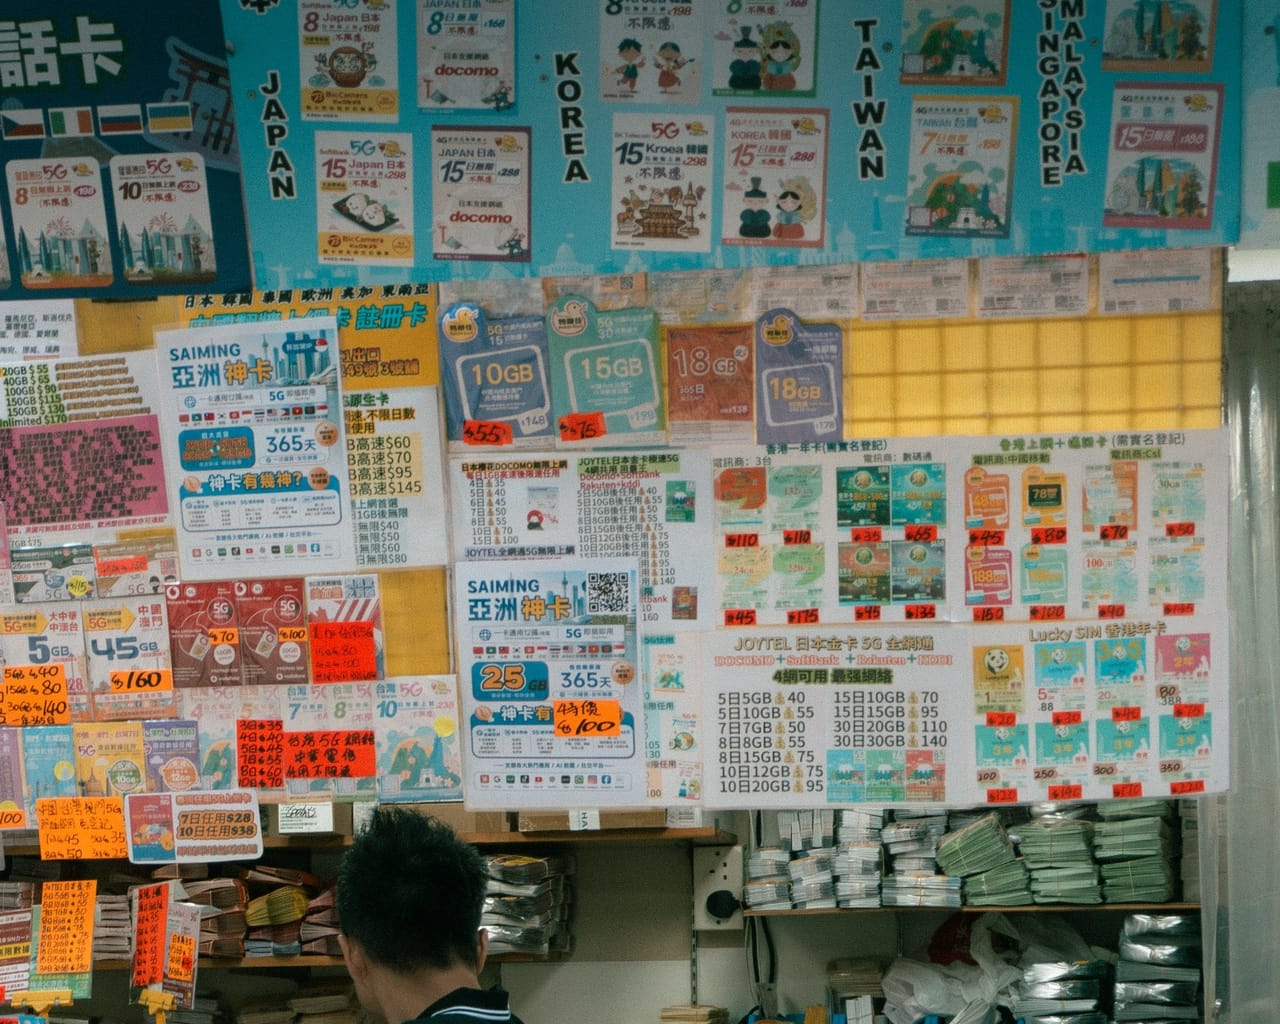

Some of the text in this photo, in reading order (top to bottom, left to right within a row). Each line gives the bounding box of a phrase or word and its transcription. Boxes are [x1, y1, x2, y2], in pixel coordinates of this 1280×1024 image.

[304, 12, 380, 32] 8 Japan 日本
[434, 65, 499, 76] docomo
[1061, 0, 1085, 174] MALAYSIA
[853, 20, 884, 179] TAIWAN
[554, 52, 589, 182] KOREA
[261, 72, 294, 198] JAPAN
[731, 130, 792, 141] KOREA 韓國
[1119, 126, 1144, 148] 15
[350, 139, 377, 156] 5G
[438, 148, 496, 158] JAPAN 日本
[615, 142, 709, 165] 15 Kroea 韓國
[731, 144, 757, 167] 15
[321, 158, 406, 179] 15 Japan 日本
[440, 160, 466, 182] 15
[449, 212, 512, 224] docomo
[356, 304, 428, 329] 註冊卡
[169, 343, 241, 361] SAIMING
[172, 361, 272, 389] 亞洲神卡
[472, 363, 533, 385] 10GB
[581, 358, 643, 379] 15GB
[269, 392, 284, 402] 5G
[768, 376, 822, 402] 18GB
[266, 436, 317, 453] 365天
[208, 471, 303, 492] 神卡有幾神?
[468, 579, 540, 594] SAIMING
[212, 602, 229, 614] 5G
[468, 594, 572, 622] 亞洲神卡
[735, 637, 792, 651] JOYTEL
[796, 636, 860, 651] 日本金卡
[863, 637, 882, 650] 5G
[1030, 628, 1072, 643] Lucky
[1075, 625, 1103, 639] SIM
[28, 635, 69, 664] 5GB
[90, 636, 158, 661] 45GB
[481, 665, 525, 691] 25
[560, 672, 612, 689] 365天
[718, 691, 806, 706] 5日5GB 40
[833, 691, 939, 704] 15日10GB 70
[833, 735, 948, 748] 30日30GB 140
[720, 779, 824, 793] 10日20GB 95
